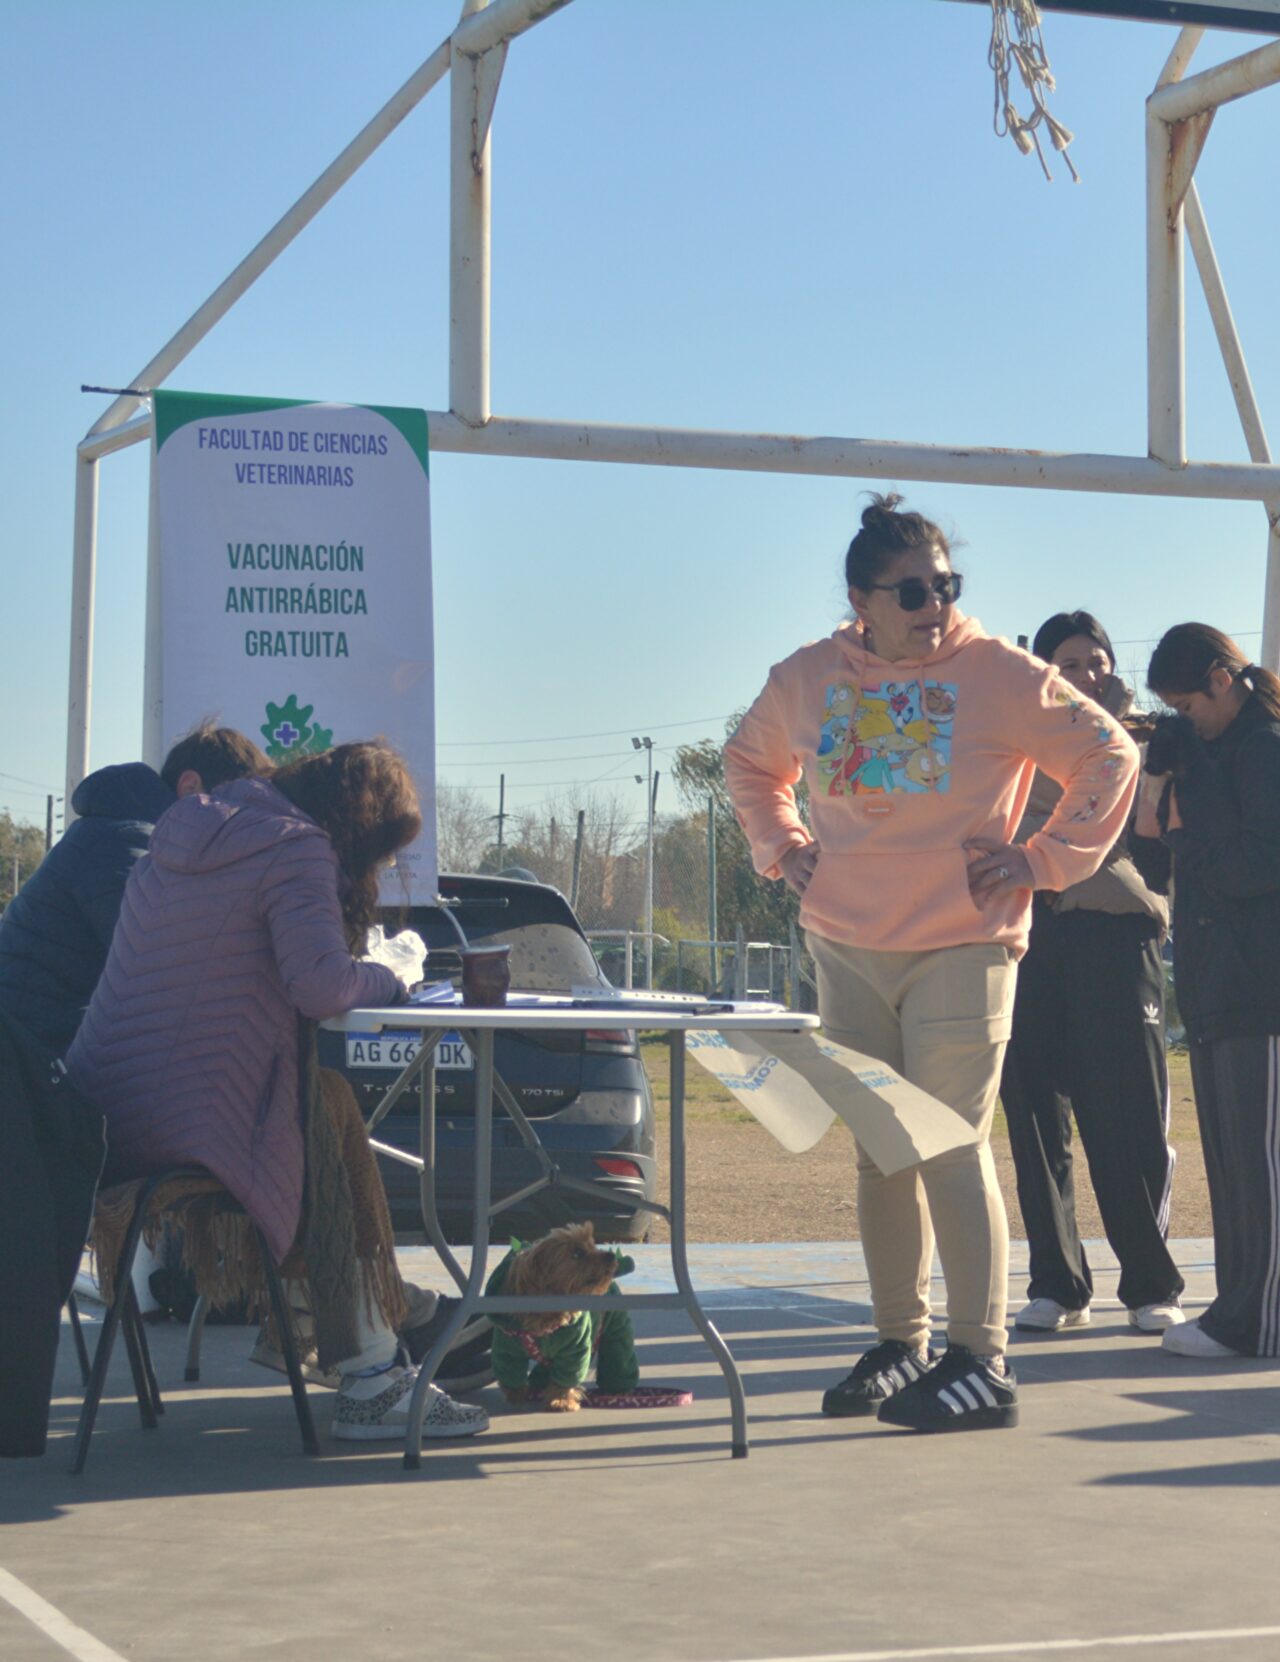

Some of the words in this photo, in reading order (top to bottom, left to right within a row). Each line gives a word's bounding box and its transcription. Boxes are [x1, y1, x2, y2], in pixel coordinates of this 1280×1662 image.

[198, 427, 284, 451] FACULTAD
[288, 431, 309, 452] DE
[313, 432, 388, 456] CIENCIAS
[235, 463, 354, 487] VETERINARIAS
[227, 540, 364, 572] VACUNACIÓN
[225, 582, 368, 615] ANTIRRÁBICA
[245, 630, 349, 658] GRATUITA
[353, 1042, 380, 1062] AG
[389, 1043, 424, 1063] 66
[439, 1044, 466, 1065] DK
[521, 1088, 542, 1096] 170
